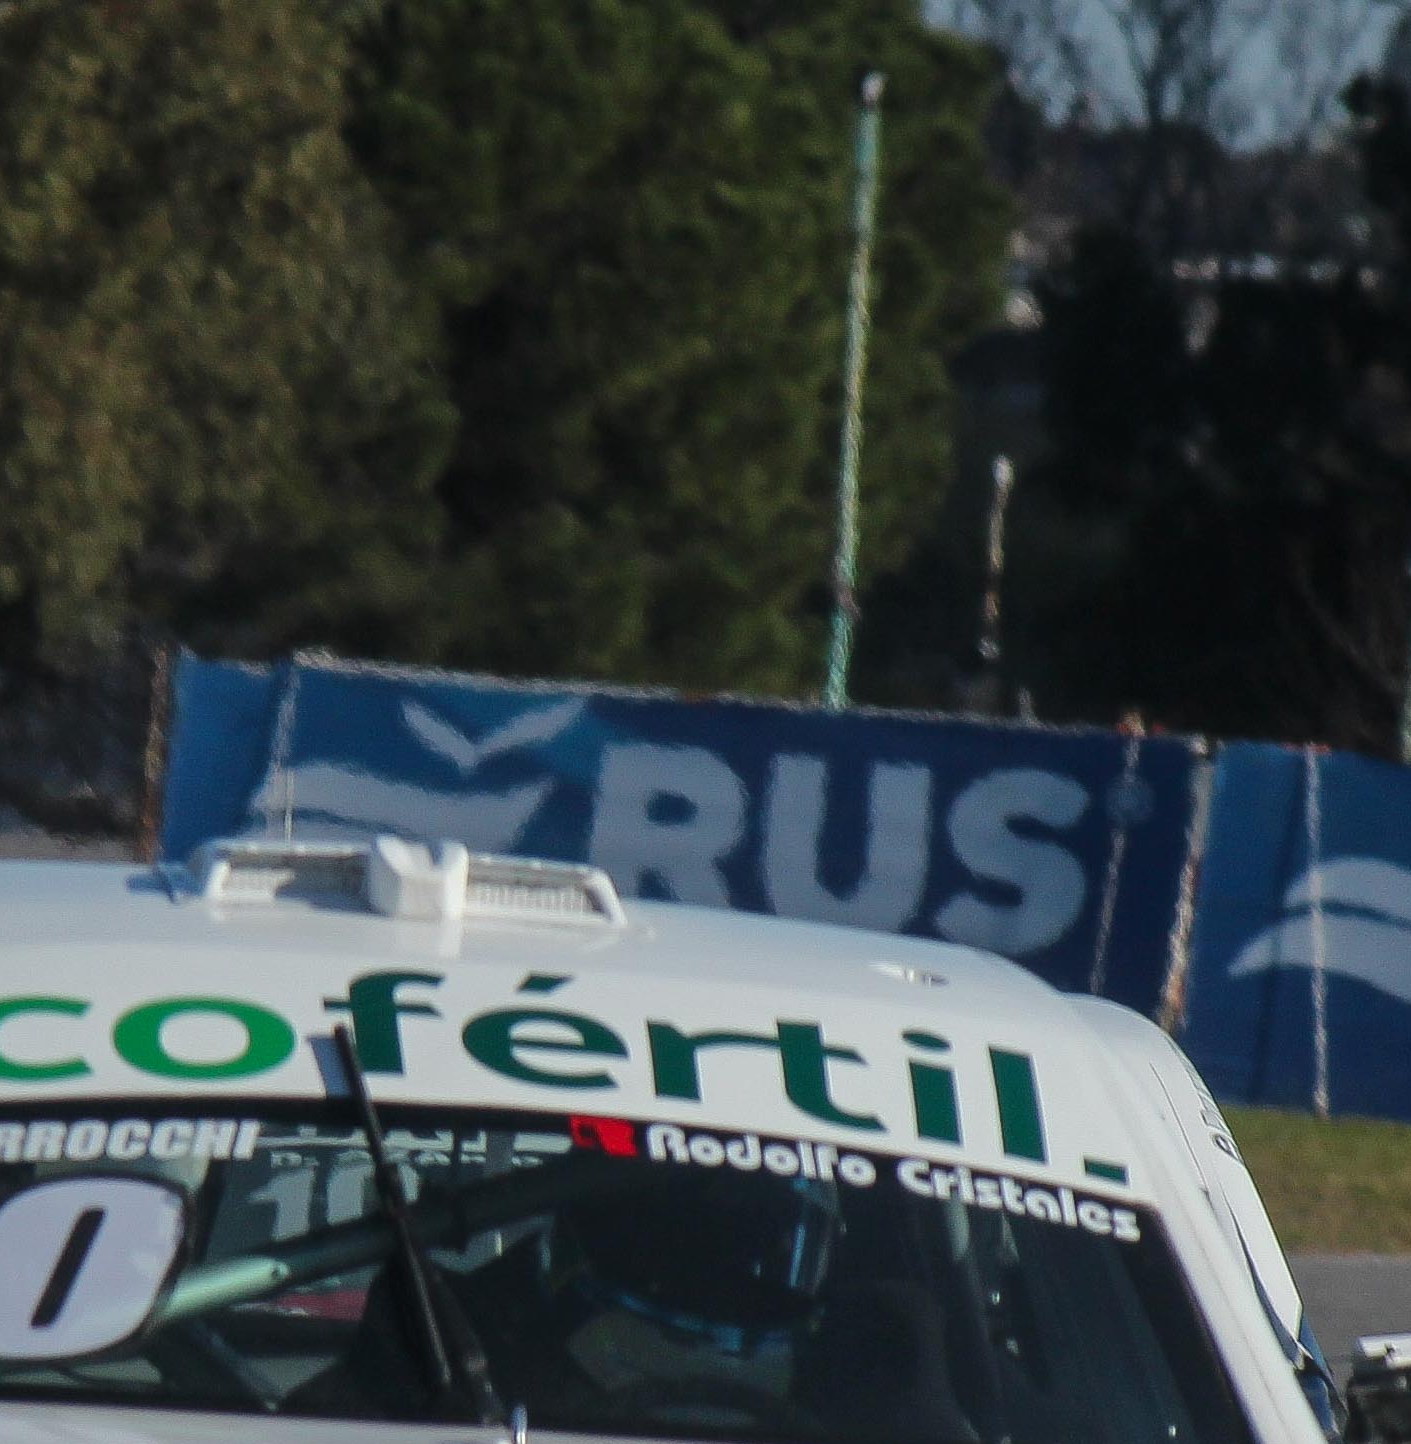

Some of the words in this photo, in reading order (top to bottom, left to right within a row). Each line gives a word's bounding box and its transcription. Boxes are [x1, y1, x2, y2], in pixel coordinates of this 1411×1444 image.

[590, 741, 1088, 953] RUS
[646, 1124, 876, 1187] Rodolfo
[897, 1157, 1141, 1243] Cristales
